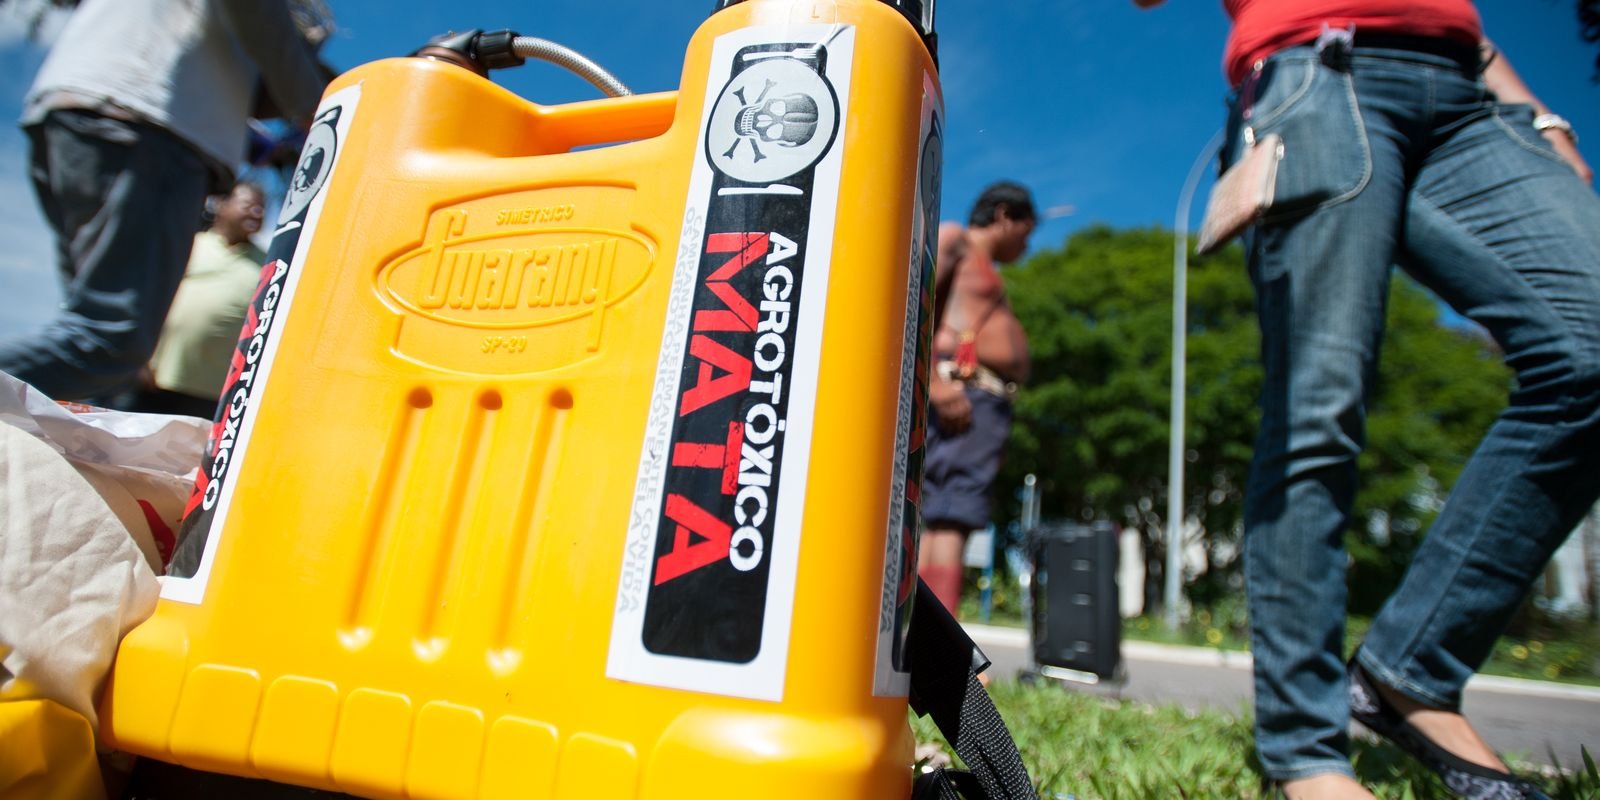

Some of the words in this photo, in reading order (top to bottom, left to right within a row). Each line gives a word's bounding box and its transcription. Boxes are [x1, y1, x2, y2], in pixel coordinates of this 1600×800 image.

[203, 259, 288, 511] AGROTÓXICO
[418, 208, 619, 352] Guarany
[654, 231, 770, 586] MATA
[729, 231, 798, 571] AGROTÓXICO
